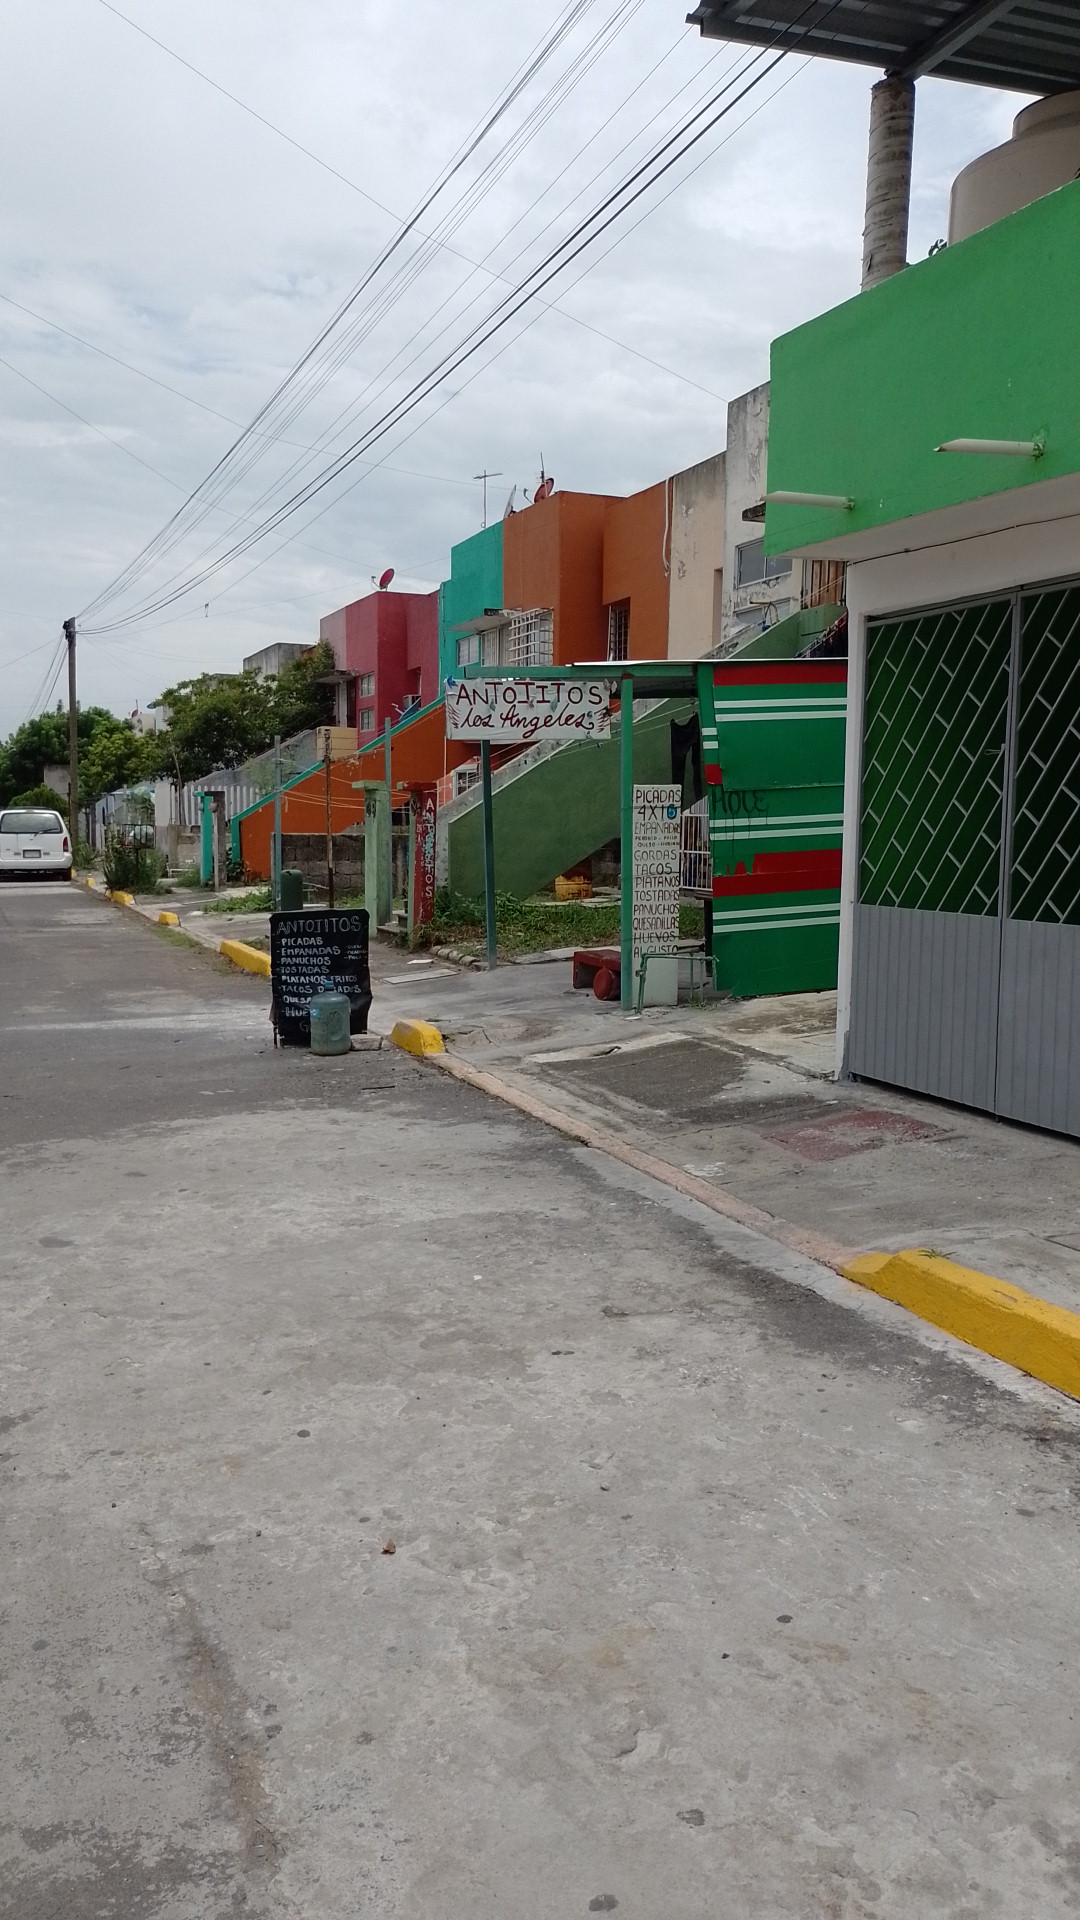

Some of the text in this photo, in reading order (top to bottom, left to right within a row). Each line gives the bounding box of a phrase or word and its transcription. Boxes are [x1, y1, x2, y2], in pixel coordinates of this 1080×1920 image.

[456, 681, 603, 705] ANTOJITOS
[499, 703, 595, 739] Angeles
[635, 789, 681, 804] PICADAS
[637, 804, 678, 821] 4X1
[633, 849, 677, 862] GORDAS
[634, 862, 673, 876] TACOS
[634, 889, 680, 902] TOSTADAS
[633, 903, 680, 916] PANUCHOS
[277, 916, 361, 935] ANTOJITOS
[281, 937, 324, 947] PICADAS
[633, 931, 677, 945] HUEVOS
[280, 946, 341, 956] EMPANADAS
[280, 956, 331, 966] PANUCHOS
[280, 966, 330, 974] TOSTADAS
[281, 985, 313, 994] TACOS
